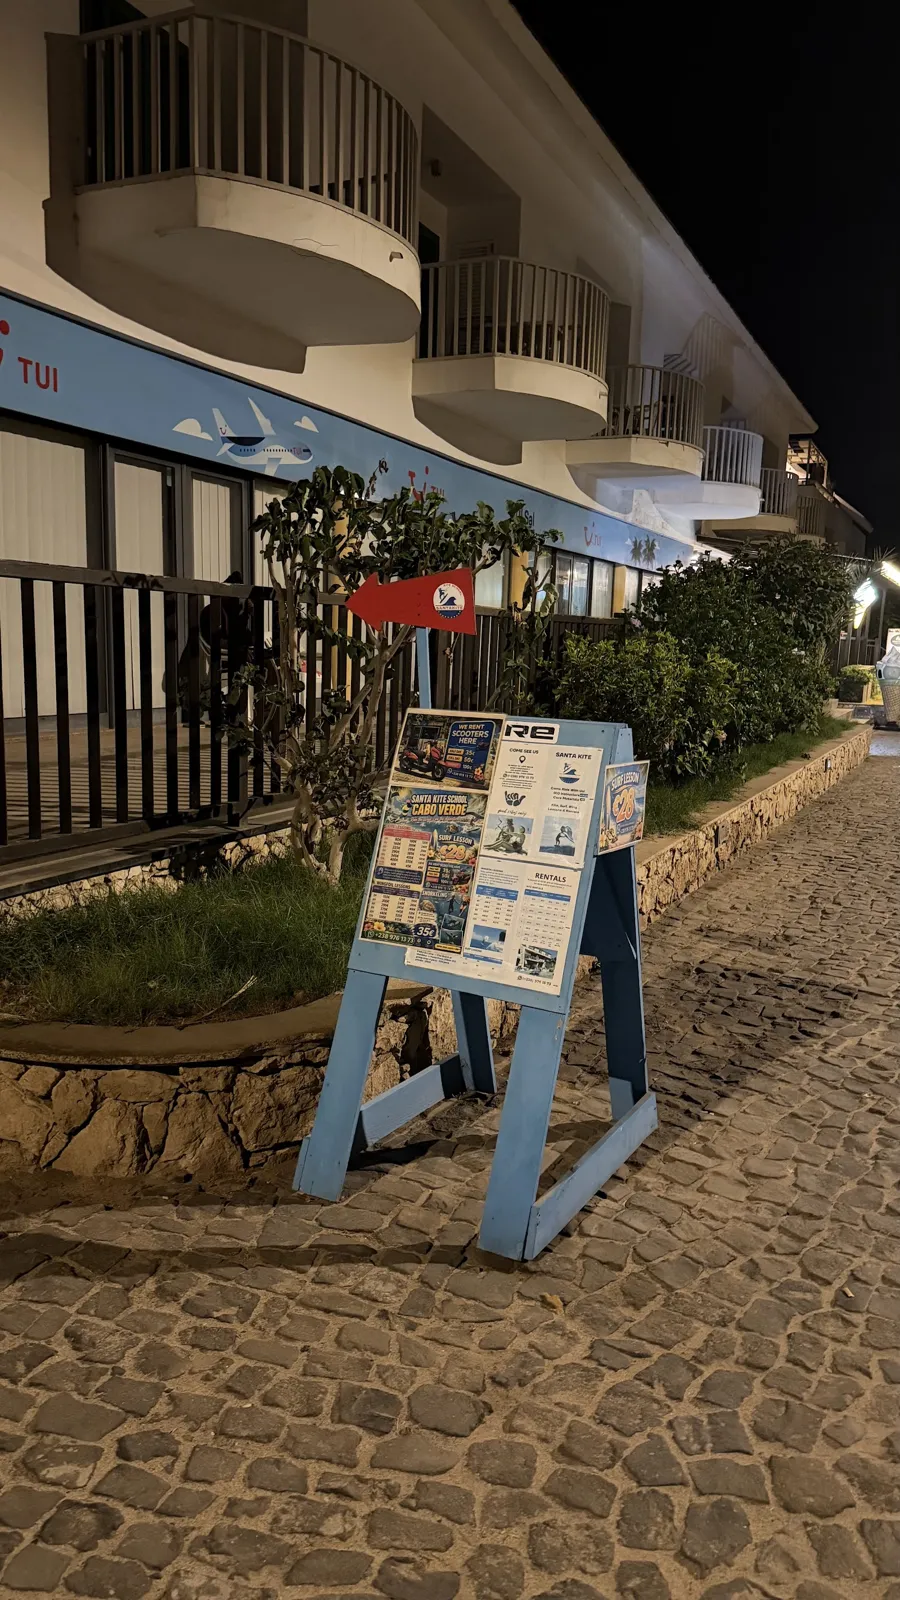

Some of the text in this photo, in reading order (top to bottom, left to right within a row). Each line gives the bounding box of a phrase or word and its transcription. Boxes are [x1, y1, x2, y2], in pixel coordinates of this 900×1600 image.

[17, 356, 58, 393] TUI
[451, 730, 489, 738] SCOOTERS
[458, 737, 478, 745] HERE
[611, 775, 623, 791] SURF
[411, 795, 467, 804] SANTA KITE SCHOOL
[613, 787, 635, 823] €28
[412, 803, 467, 816] CABO VERDE
[453, 835, 473, 845] LESSON
[440, 844, 466, 860] €28
[535, 872, 566, 883] RENTALS
[417, 927, 435, 937] 35€
